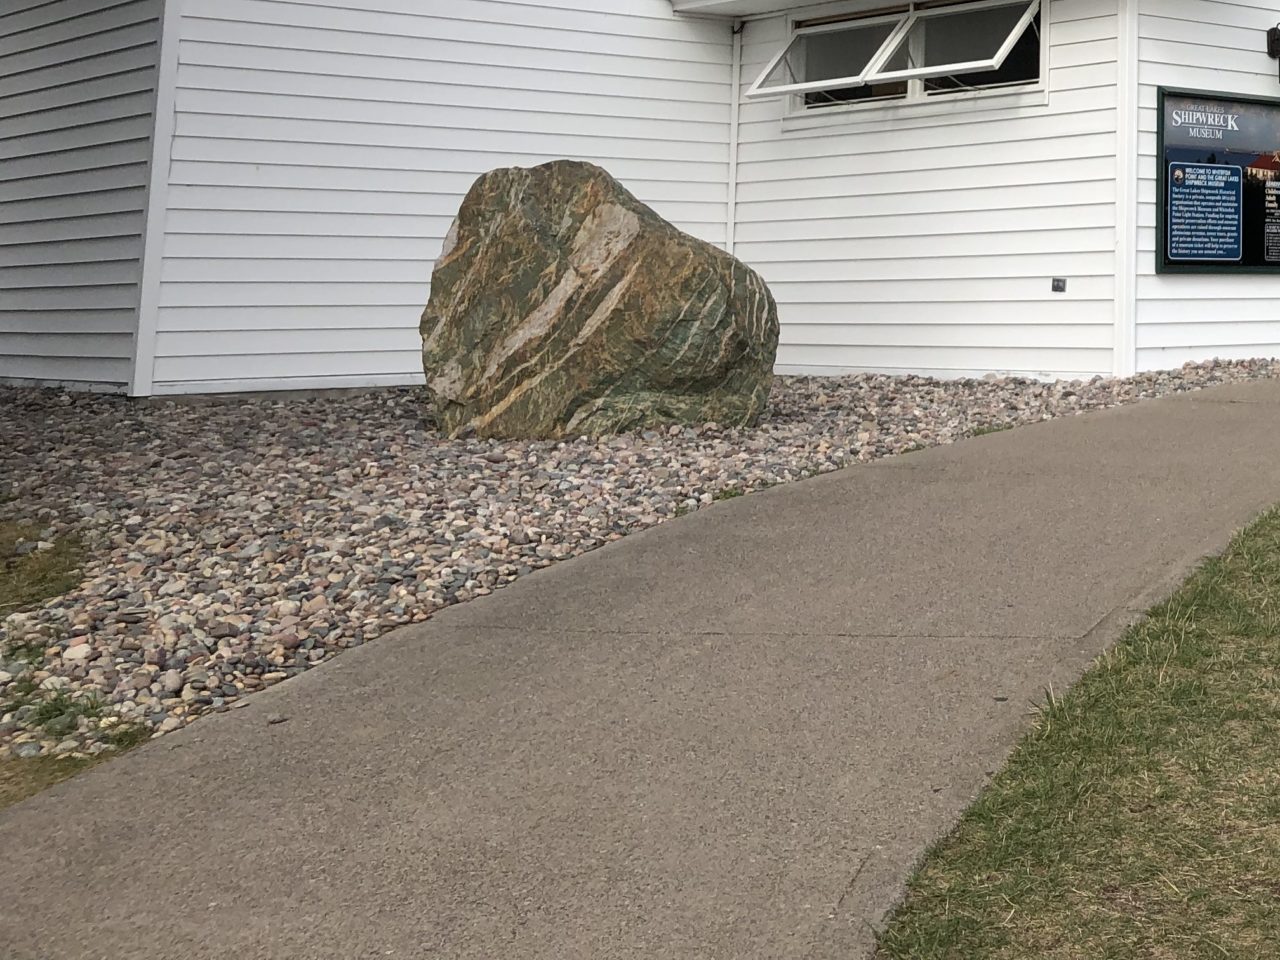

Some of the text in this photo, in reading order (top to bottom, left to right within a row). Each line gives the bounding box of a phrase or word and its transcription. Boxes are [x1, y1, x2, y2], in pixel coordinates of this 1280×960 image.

[1207, 105, 1224, 113] LAKES
[1172, 110, 1239, 130] SHIPWRECK
[1190, 128, 1222, 139] MUSEUM
